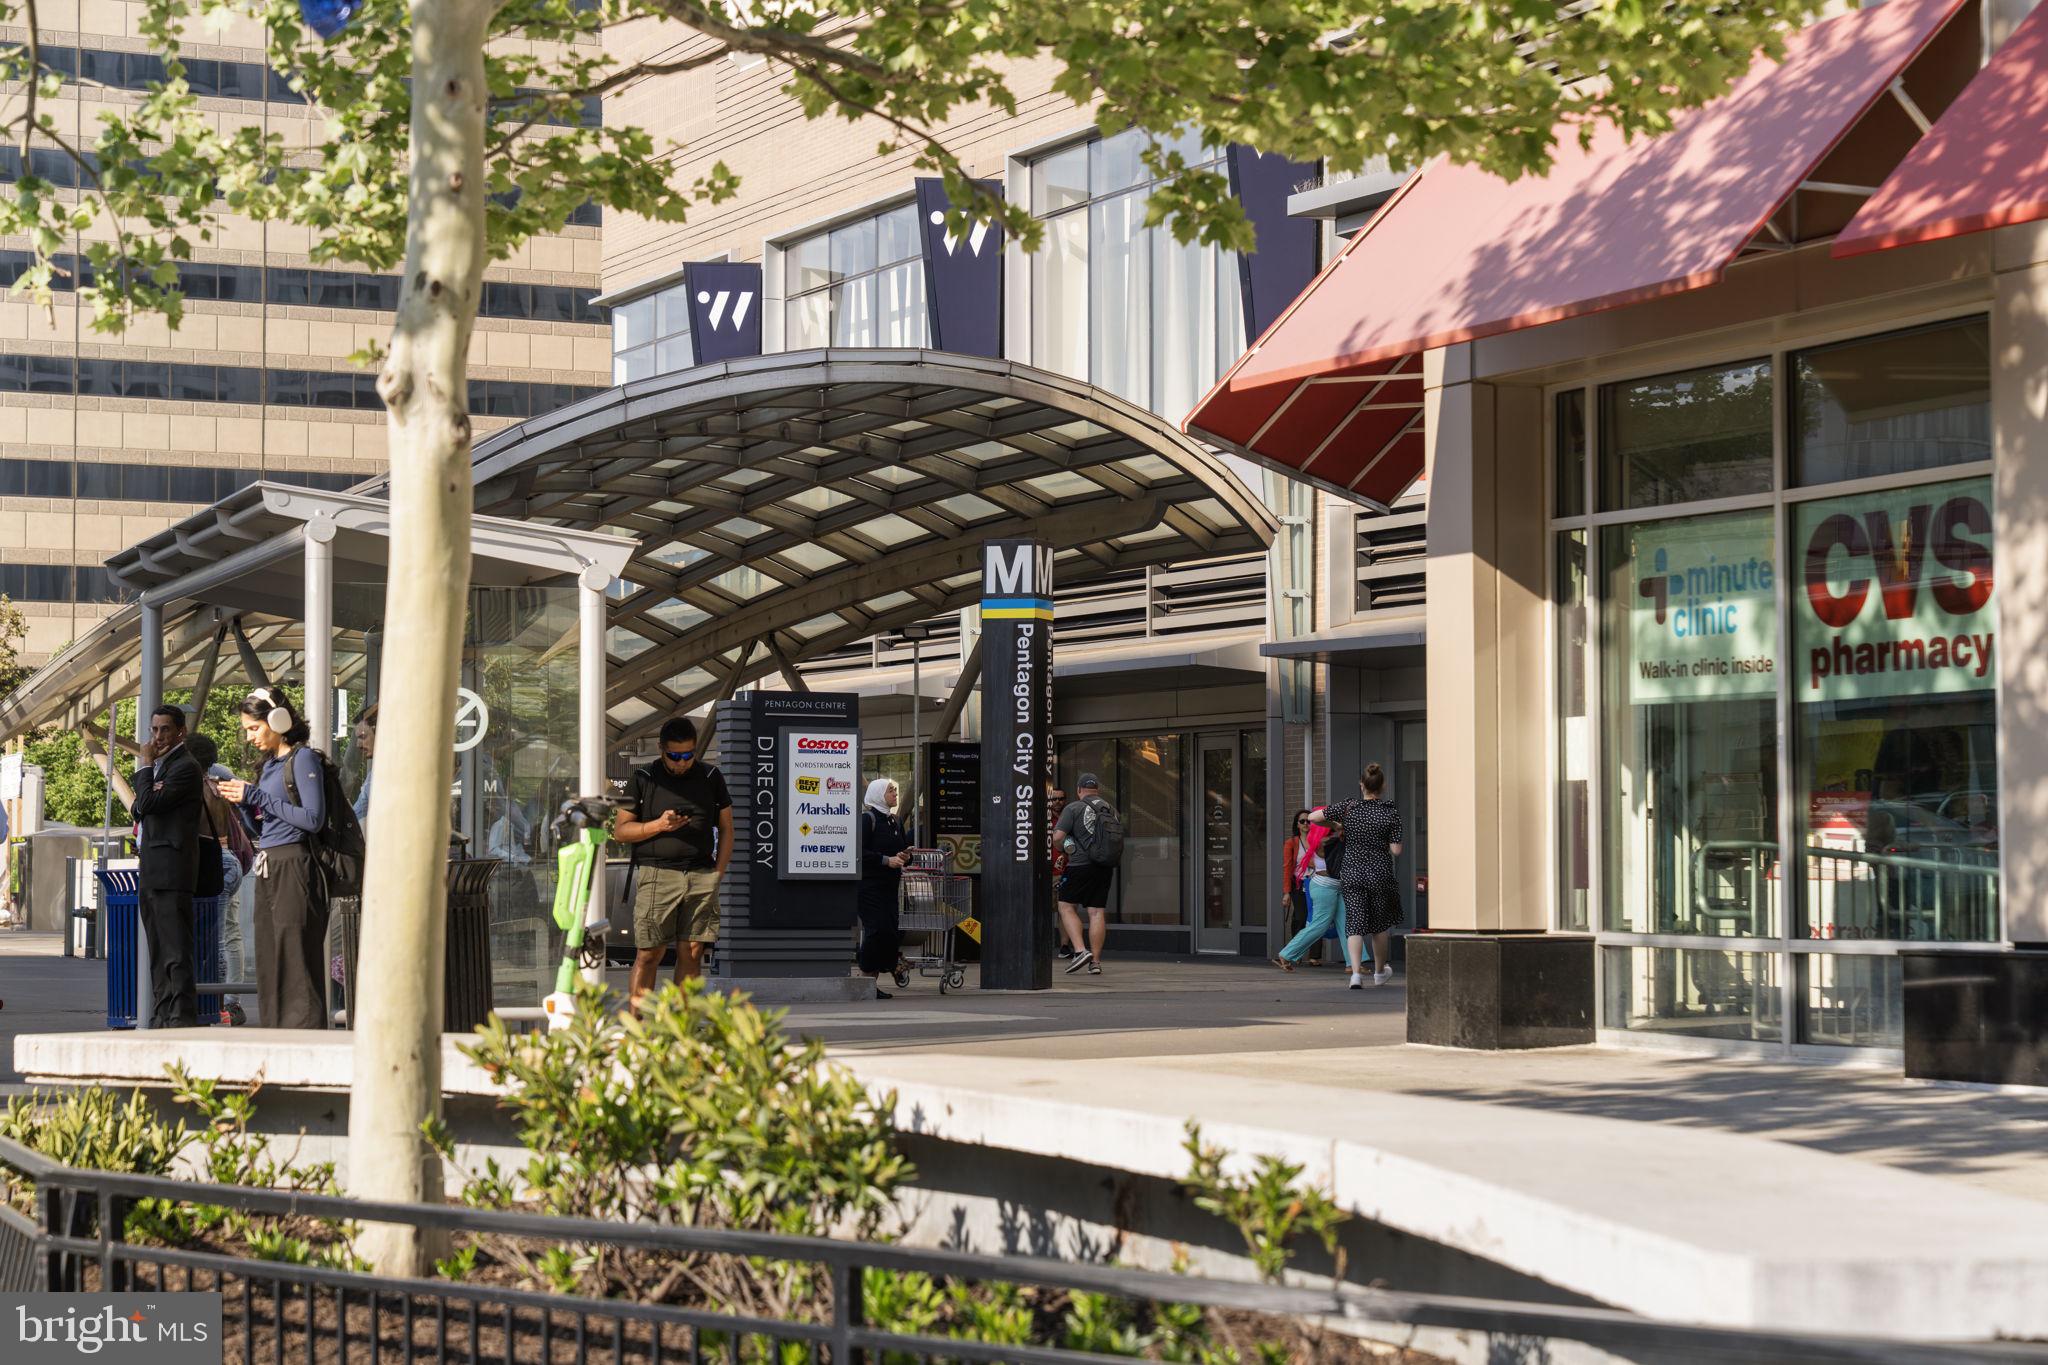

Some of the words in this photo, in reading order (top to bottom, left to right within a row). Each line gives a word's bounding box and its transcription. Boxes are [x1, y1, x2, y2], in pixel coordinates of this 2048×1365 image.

[986, 545, 1032, 593] M
[1036, 545, 1053, 595] M
[1688, 556, 1774, 595] minute
[1805, 496, 1994, 628] CVS
[1673, 596, 1738, 638] clinic
[1014, 624, 1034, 723] Pentagon
[1046, 626, 1054, 723] Pentagon
[1640, 659, 1688, 679] Walk-in
[1692, 657, 1728, 676] clinic
[1731, 655, 1773, 674] inside
[1811, 633, 1994, 689] pharmacy
[765, 700, 812, 709] PENTAGON
[1013, 732, 1034, 775] City
[1046, 734, 1054, 775] City
[757, 736, 774, 869] DIRECTORY
[796, 803, 850, 815] Marshalls
[1016, 785, 1034, 861] Station
[1046, 785, 1054, 861] Station
[800, 845, 818, 853] five
